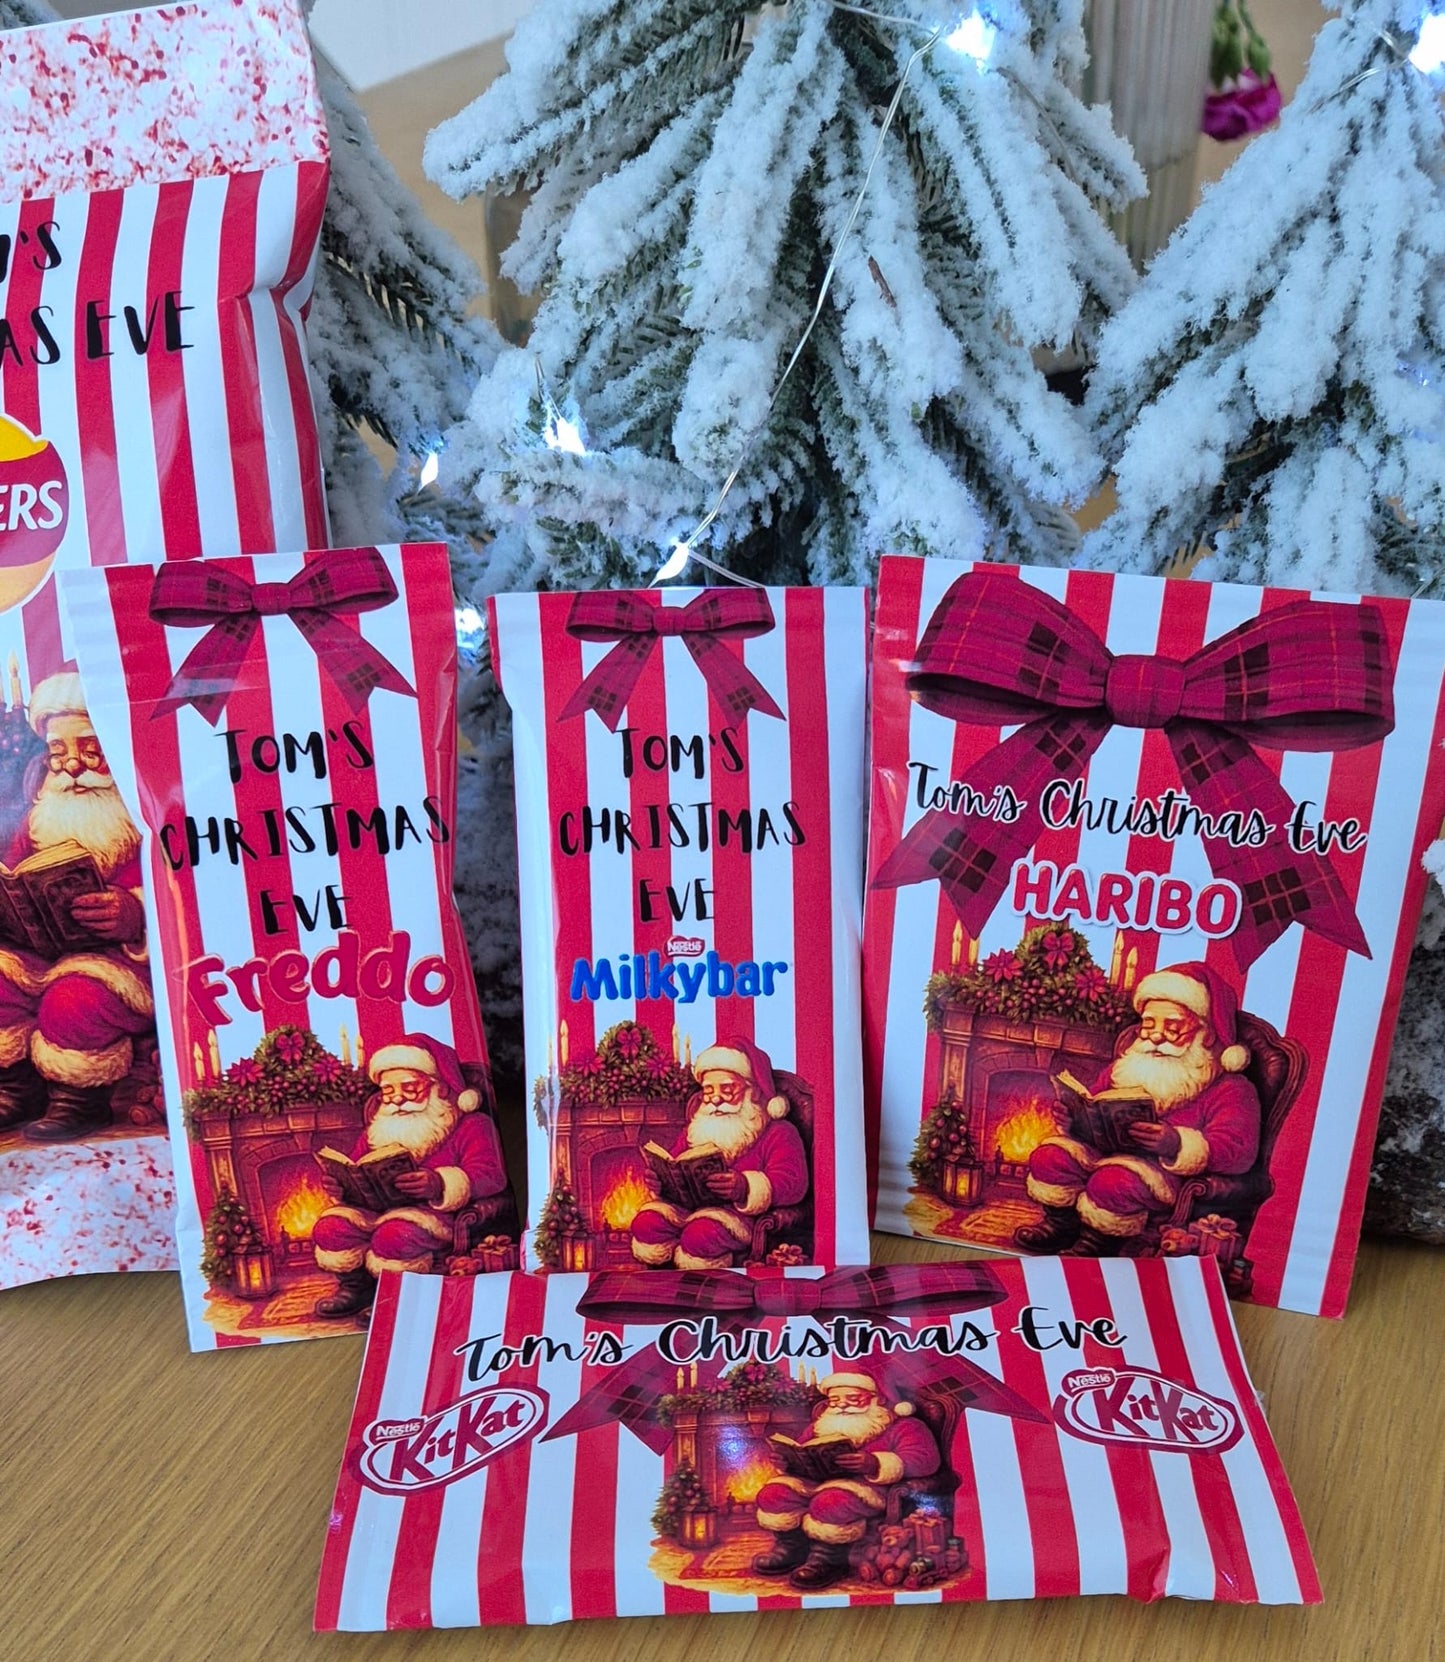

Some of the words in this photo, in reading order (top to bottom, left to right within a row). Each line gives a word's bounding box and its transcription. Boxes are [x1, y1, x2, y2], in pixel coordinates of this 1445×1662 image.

[87, 291, 195, 359] EVE
[214, 721, 374, 784] TOM'S
[614, 727, 744, 779] TOM'S
[160, 796, 450, 870] CHRISTMAS
[559, 801, 806, 856] CHRISTMAS
[908, 761, 1025, 822] Tom's
[1041, 779, 1274, 847] Christmas
[1287, 800, 1367, 854] Eve
[260, 884, 352, 935] EVE
[639, 878, 717, 922] EVE
[1013, 864, 1241, 935] HARIBO
[176, 930, 456, 1025] Freddo
[570, 950, 788, 1004] Milkybar
[455, 1333, 633, 1382] Tom's
[658, 1316, 997, 1363] Christmas
[1013, 1306, 1128, 1351] Eve
